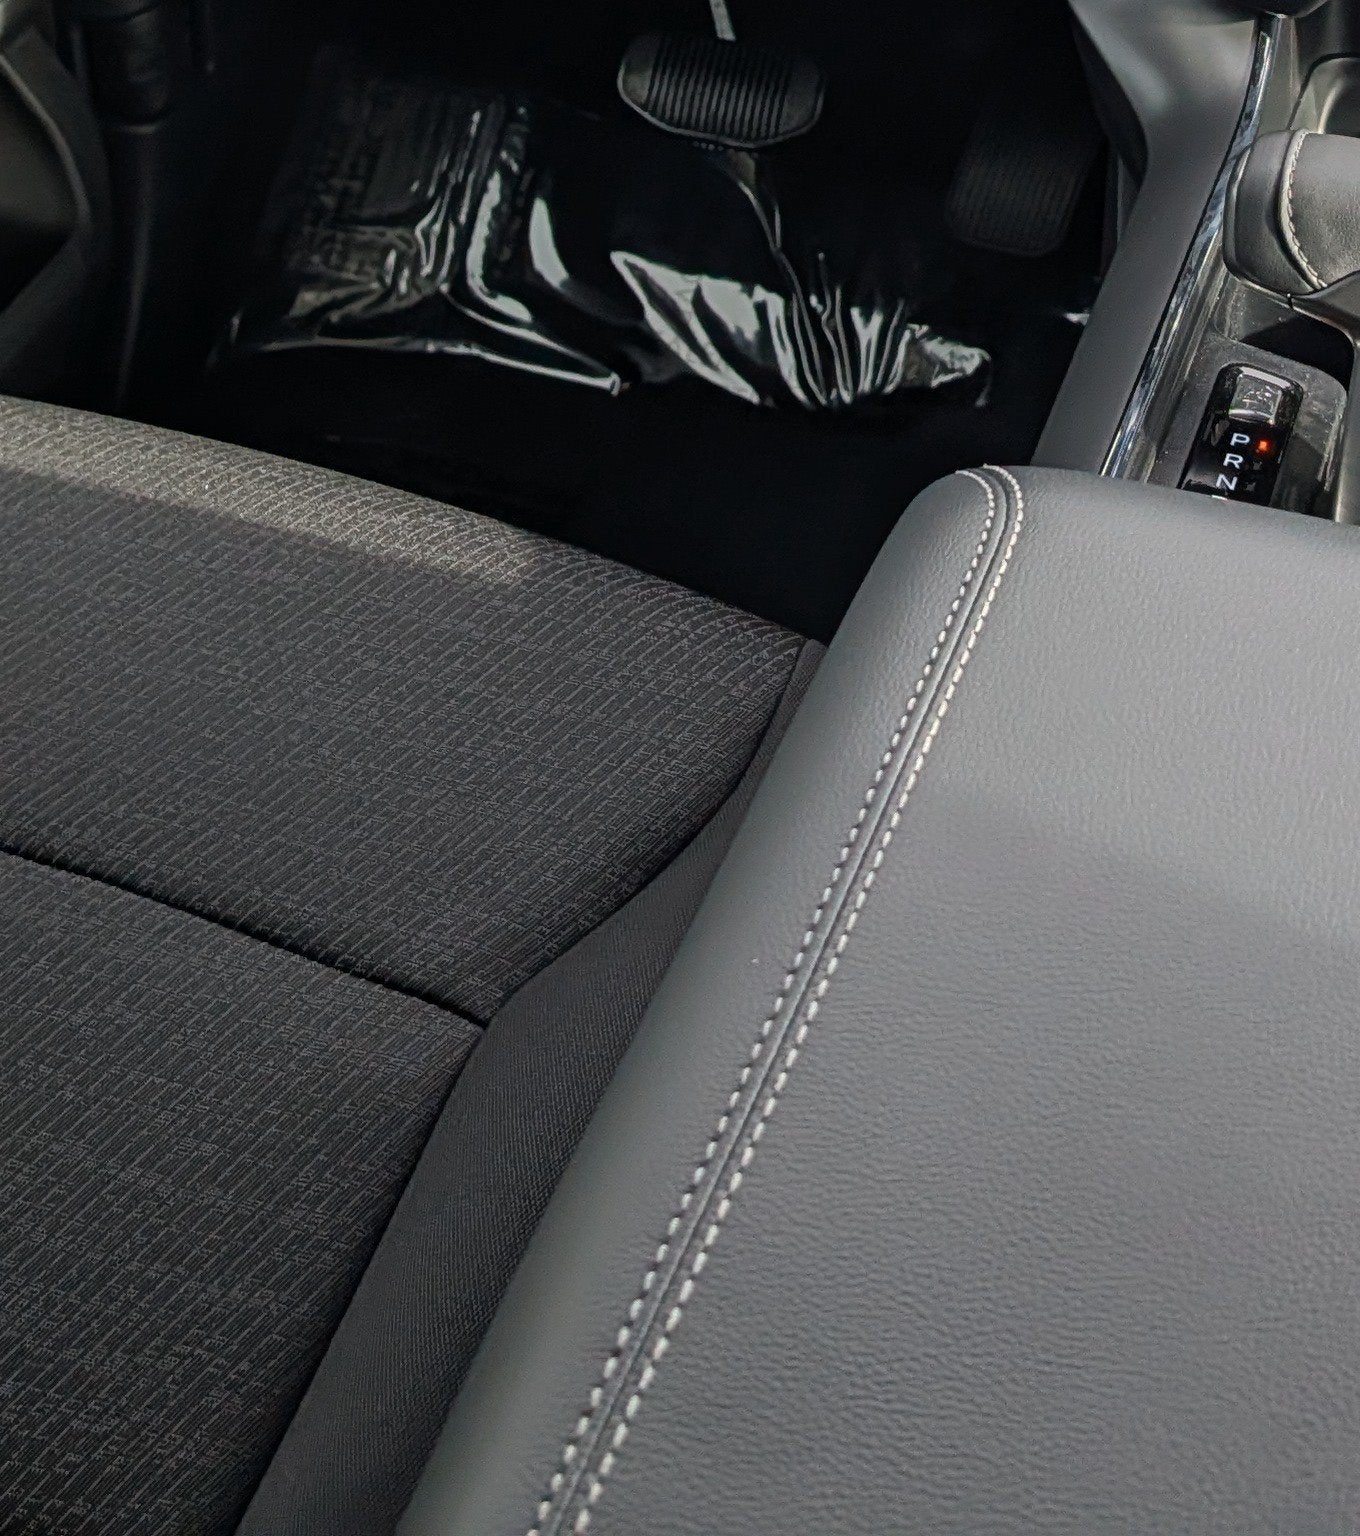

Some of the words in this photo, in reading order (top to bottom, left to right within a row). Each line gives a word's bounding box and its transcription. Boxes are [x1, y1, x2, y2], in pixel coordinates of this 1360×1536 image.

[1230, 432, 1251, 447] P
[1223, 453, 1244, 469] R
[1215, 474, 1238, 491] N
